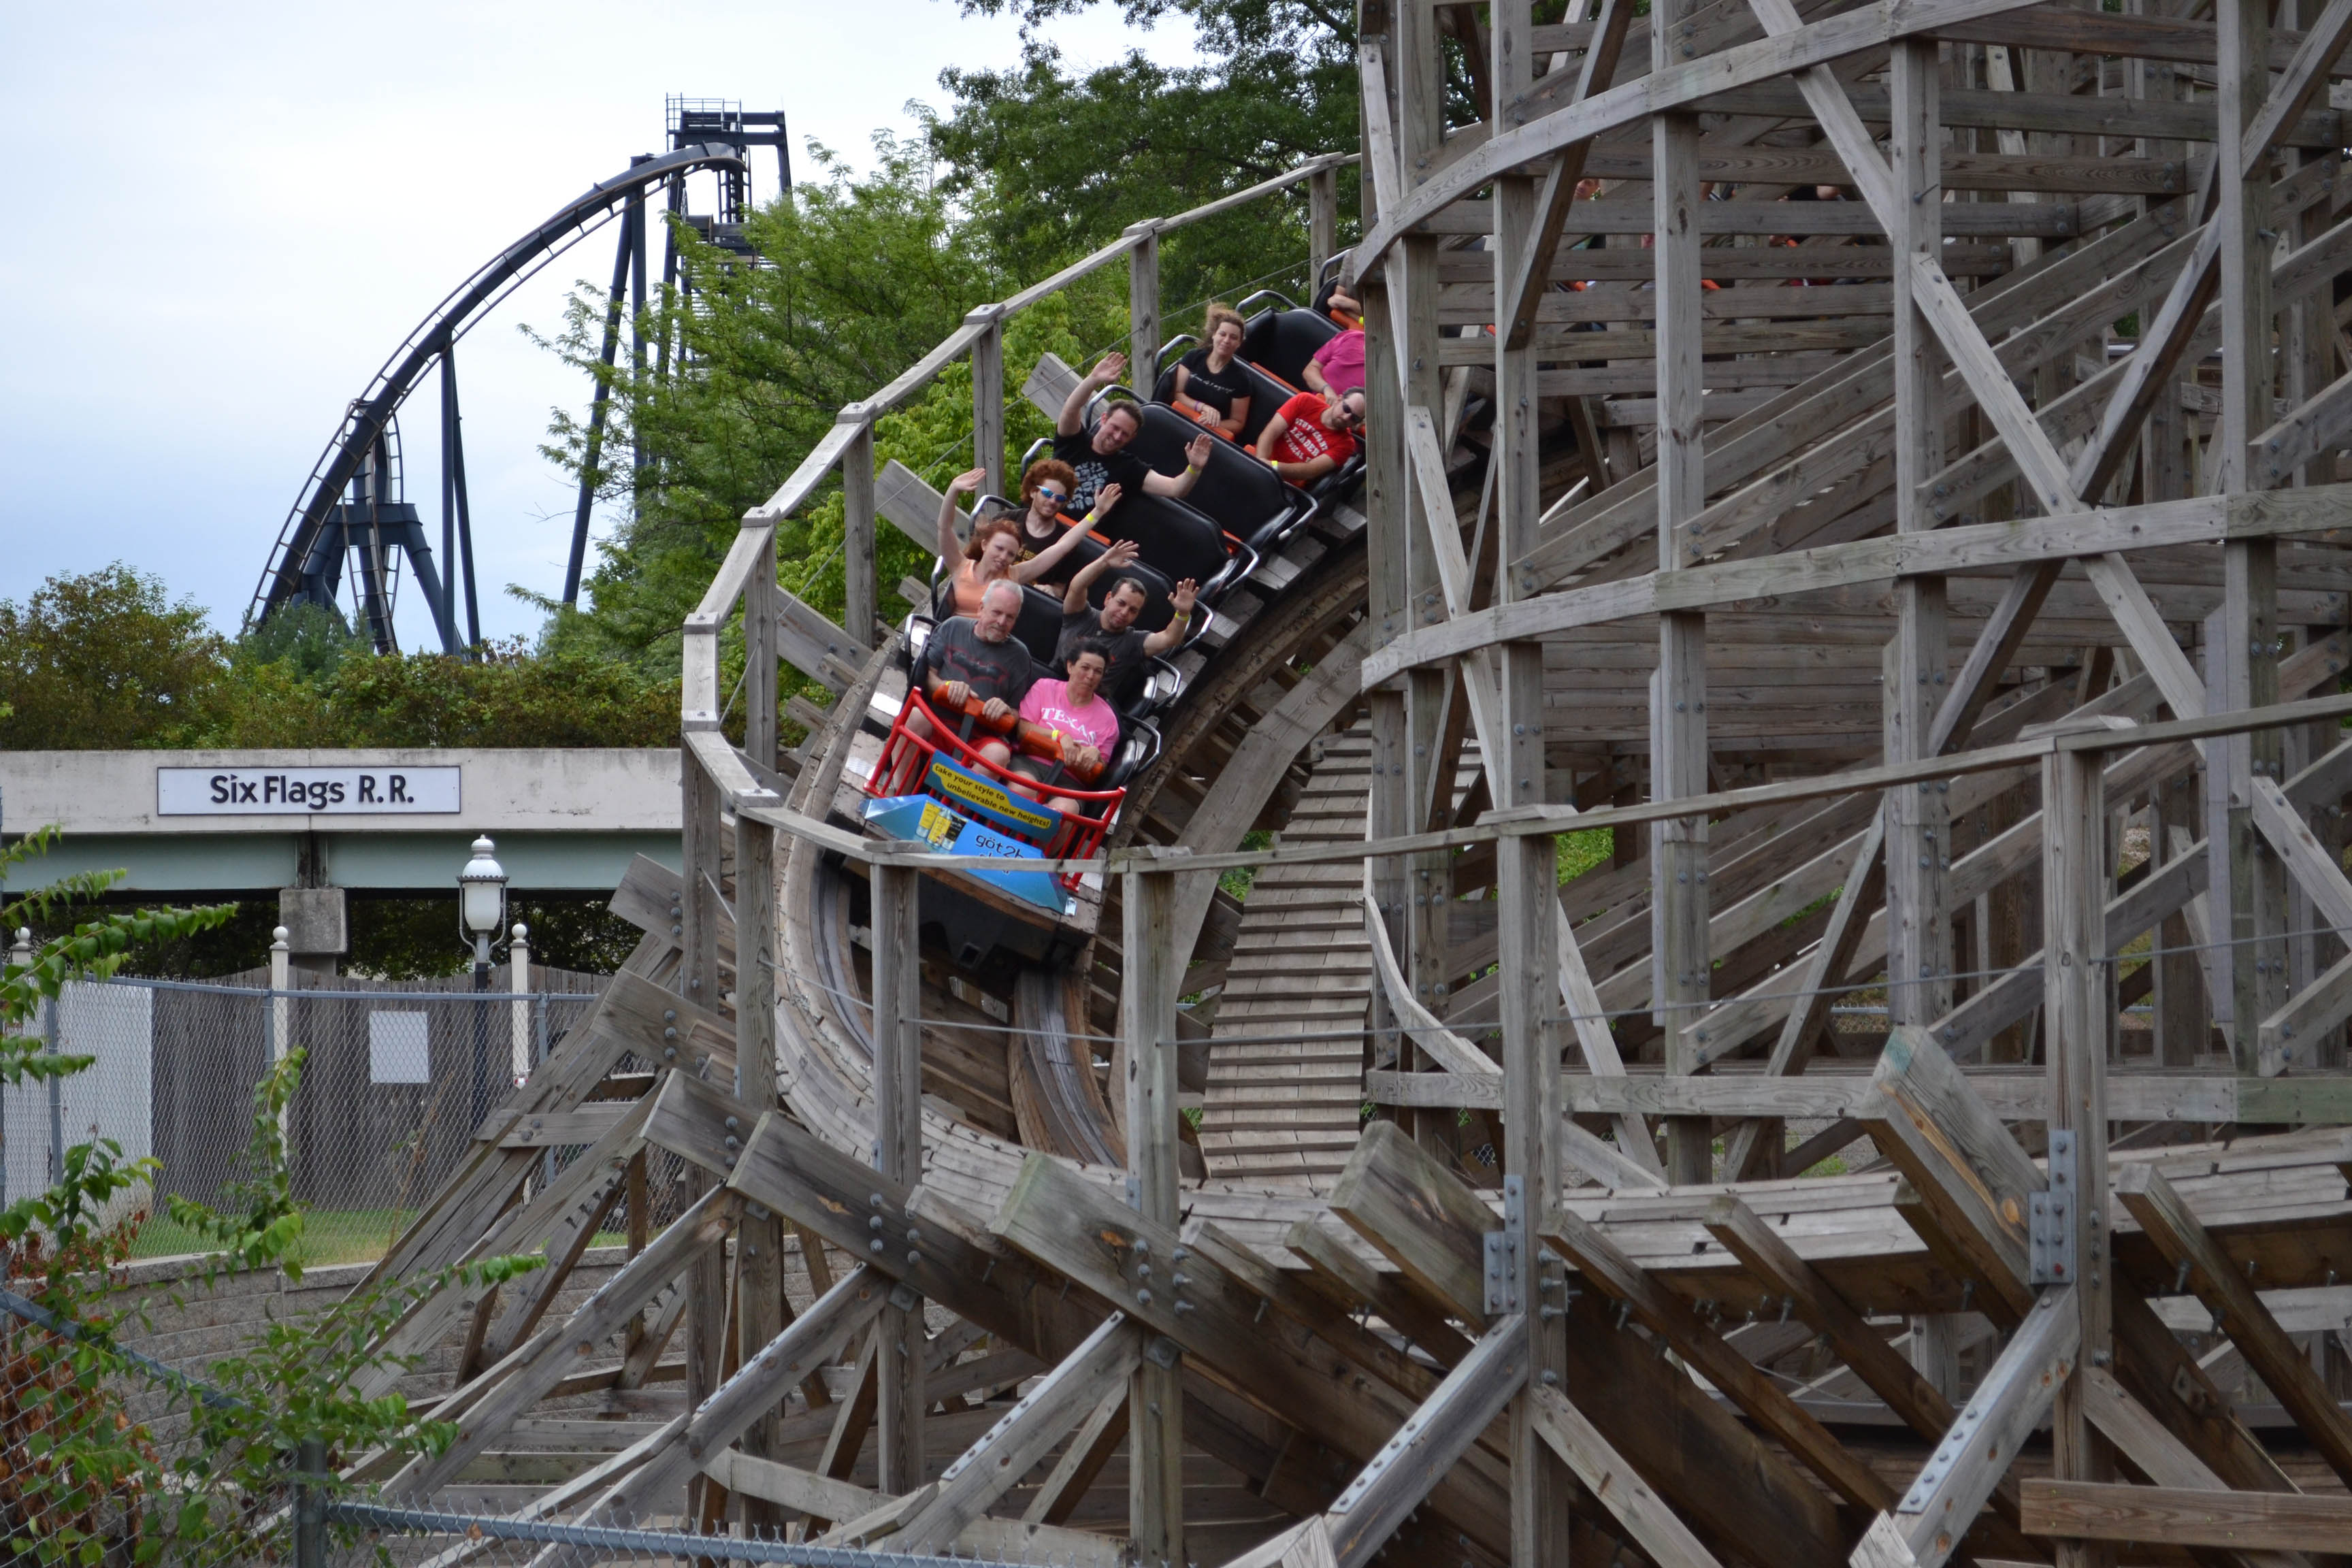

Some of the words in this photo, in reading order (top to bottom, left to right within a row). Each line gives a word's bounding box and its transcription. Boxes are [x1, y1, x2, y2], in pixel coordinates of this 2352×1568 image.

[1290, 427, 1320, 456] LEADER
[210, 774, 258, 803] Six
[263, 775, 345, 810] Flags
[935, 764, 952, 777] take
[954, 775, 973, 786] your
[975, 783, 994, 797] style
[947, 782, 997, 808] unbelievable
[998, 805, 1016, 815] new
[1017, 812, 1050, 827] heights!
